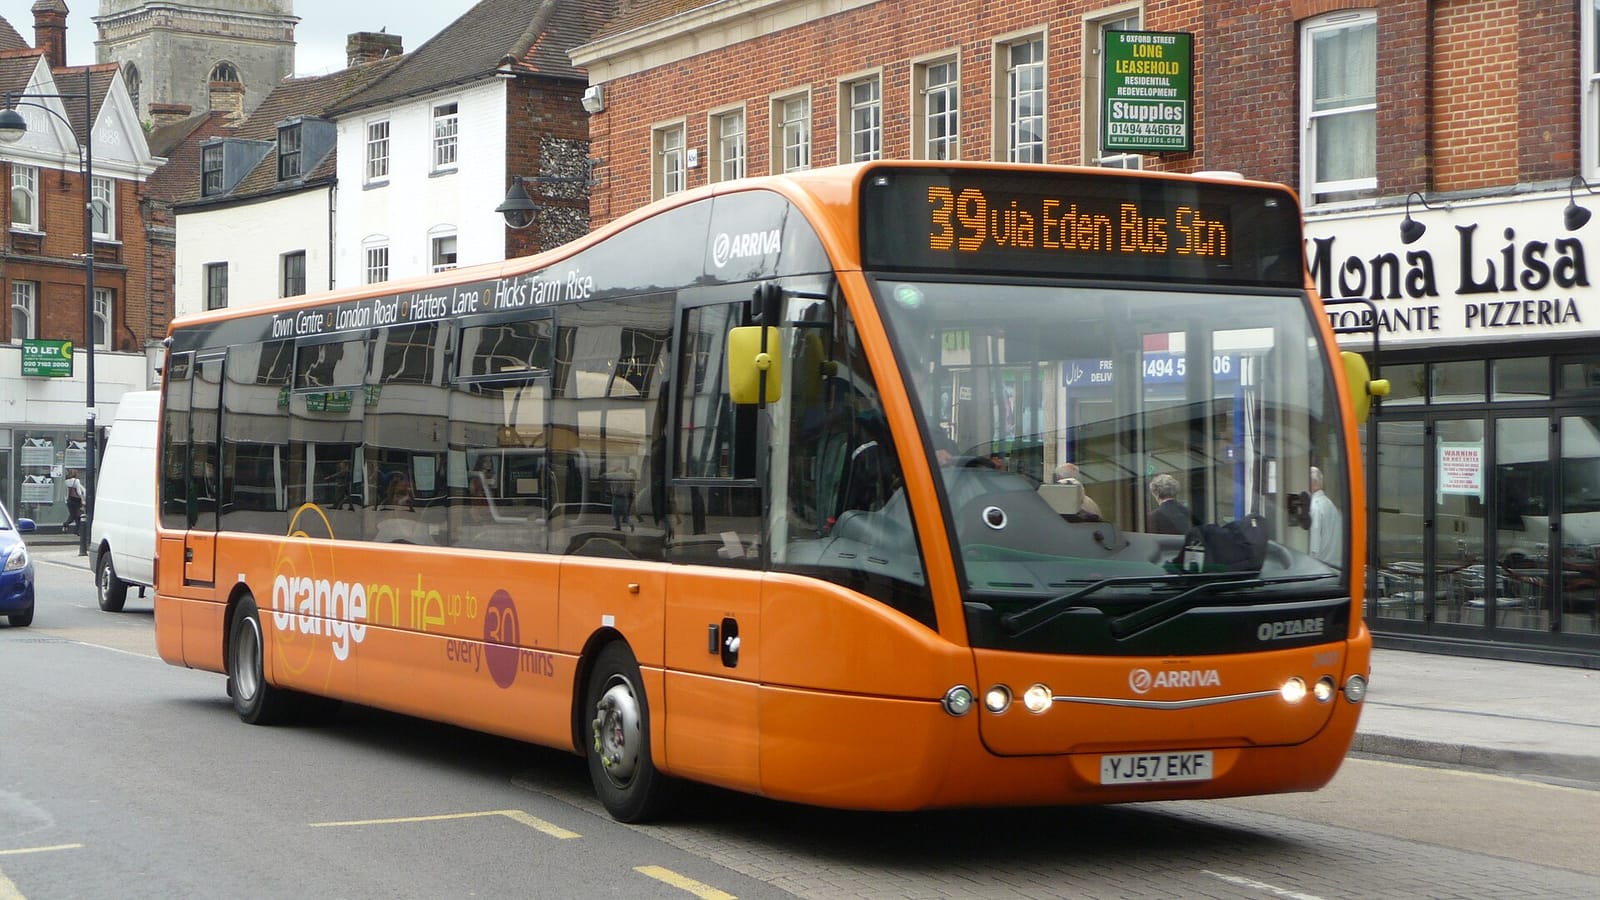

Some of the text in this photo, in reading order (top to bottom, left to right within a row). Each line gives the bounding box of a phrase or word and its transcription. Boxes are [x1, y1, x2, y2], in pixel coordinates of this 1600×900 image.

[1119, 34, 1176, 45] 5 OXFORD STREET
[1133, 44, 1163, 58] LONG
[1115, 59, 1179, 75] LEASEHOLD
[1124, 76, 1171, 86] RESIDENTIAL
[1117, 87, 1177, 97] REDEVELOPMENT
[1112, 101, 1182, 122] Stupples
[1111, 123, 1182, 136] 01494 446612
[1111, 136, 1182, 144] www.stupples.com
[928, 186, 1226, 256] 39 via Eden Bus Stn
[729, 229, 781, 259] ARRIVA
[1303, 223, 1591, 300] Mona Lisa
[271, 270, 593, 339] Town Centre London Road Hatters Lane Hicks Farm Rise
[1464, 297, 1582, 329] PIZZERIA
[24, 346, 60, 355] TO LET
[1099, 360, 1113, 370] FRE
[1142, 355, 1231, 377] 1494 5 06
[1091, 372, 1113, 383] DELIV
[447, 590, 478, 624] up to
[1257, 617, 1325, 641] OPTARE
[446, 606, 554, 678] every 30 mins
[1153, 669, 1222, 688] ARRIVA
[1108, 754, 1205, 779] YJ57 EKF
